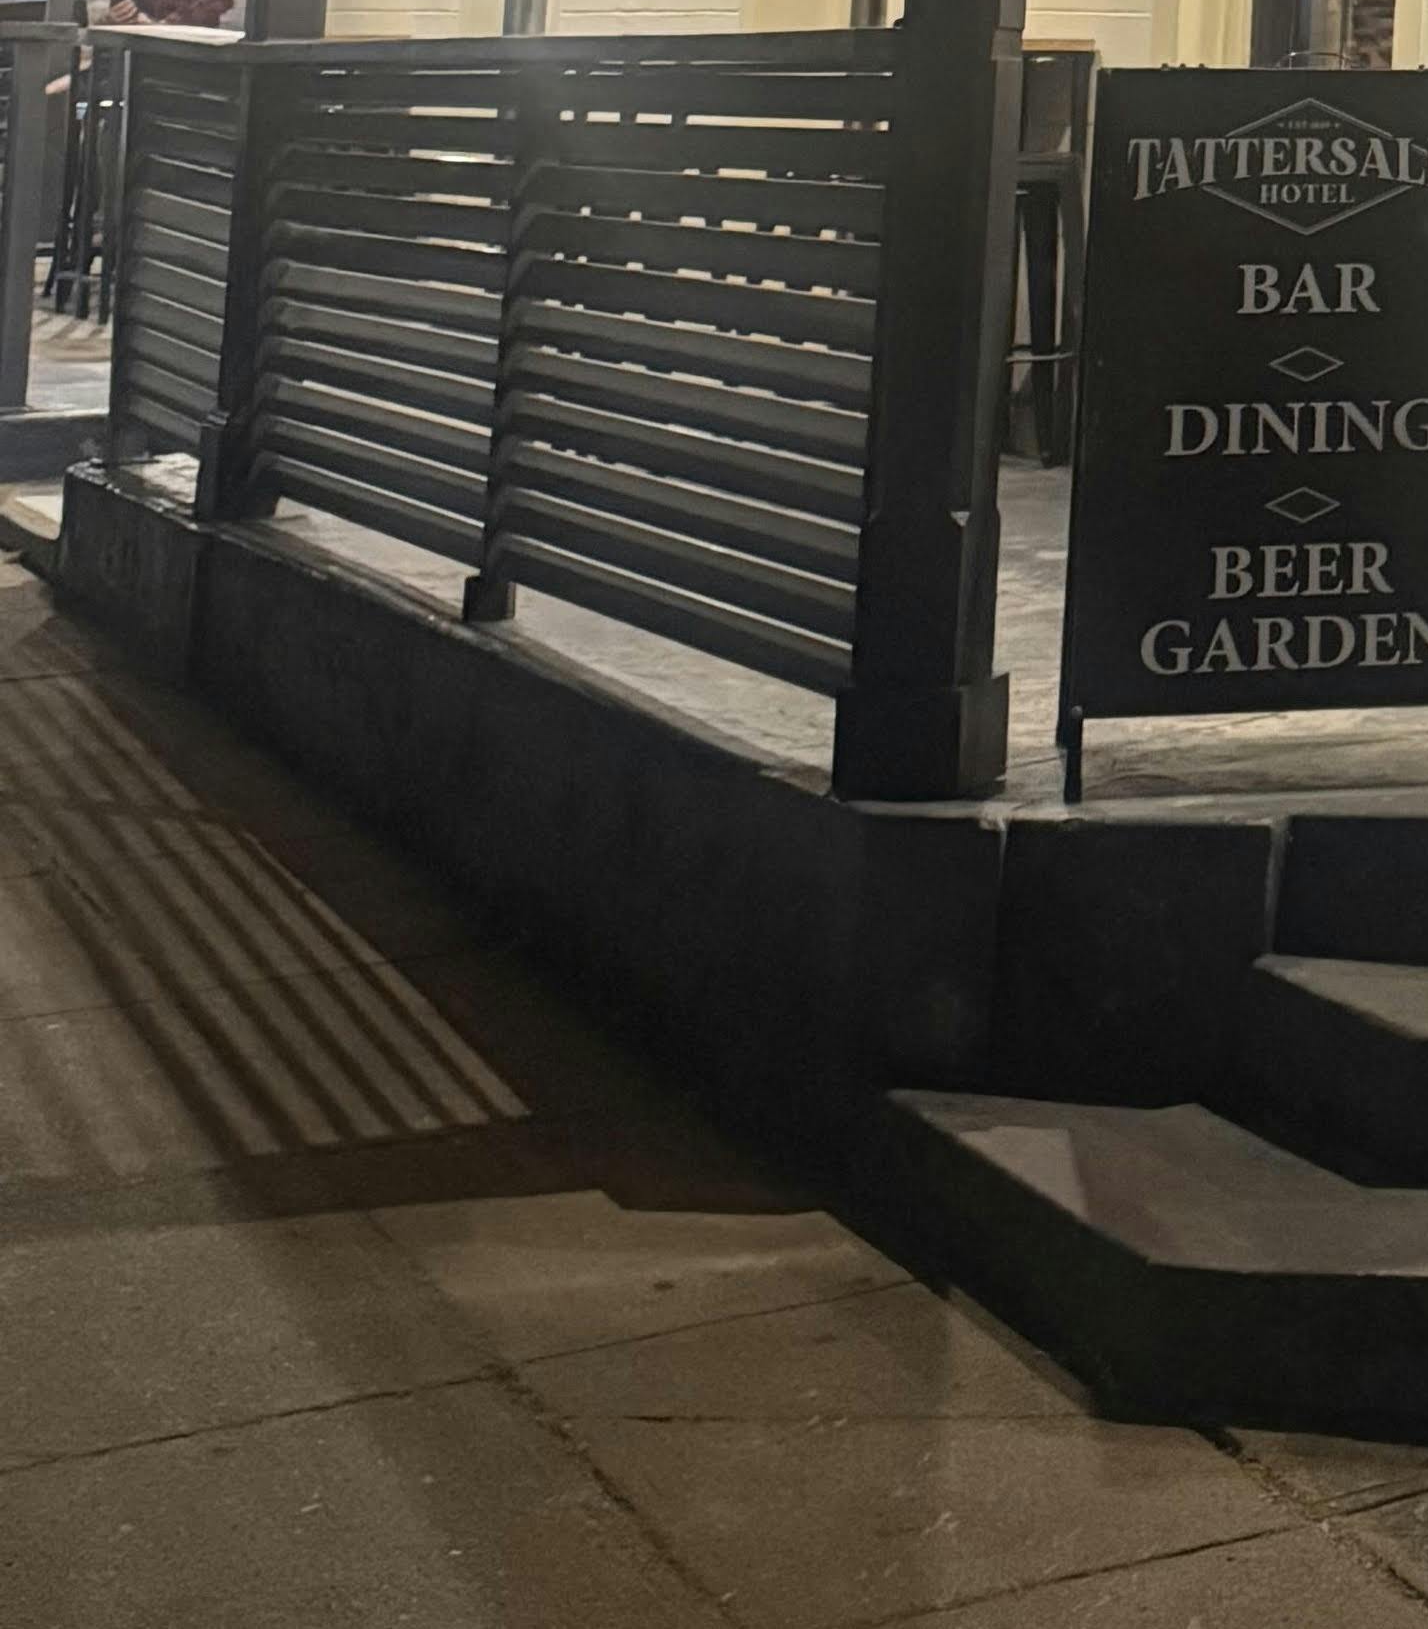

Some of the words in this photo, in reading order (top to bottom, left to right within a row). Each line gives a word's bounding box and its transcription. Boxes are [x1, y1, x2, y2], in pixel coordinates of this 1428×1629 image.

[1259, 182, 1355, 205] HOTEL
[1237, 263, 1381, 315] BAR
[1208, 542, 1394, 601] BEER
